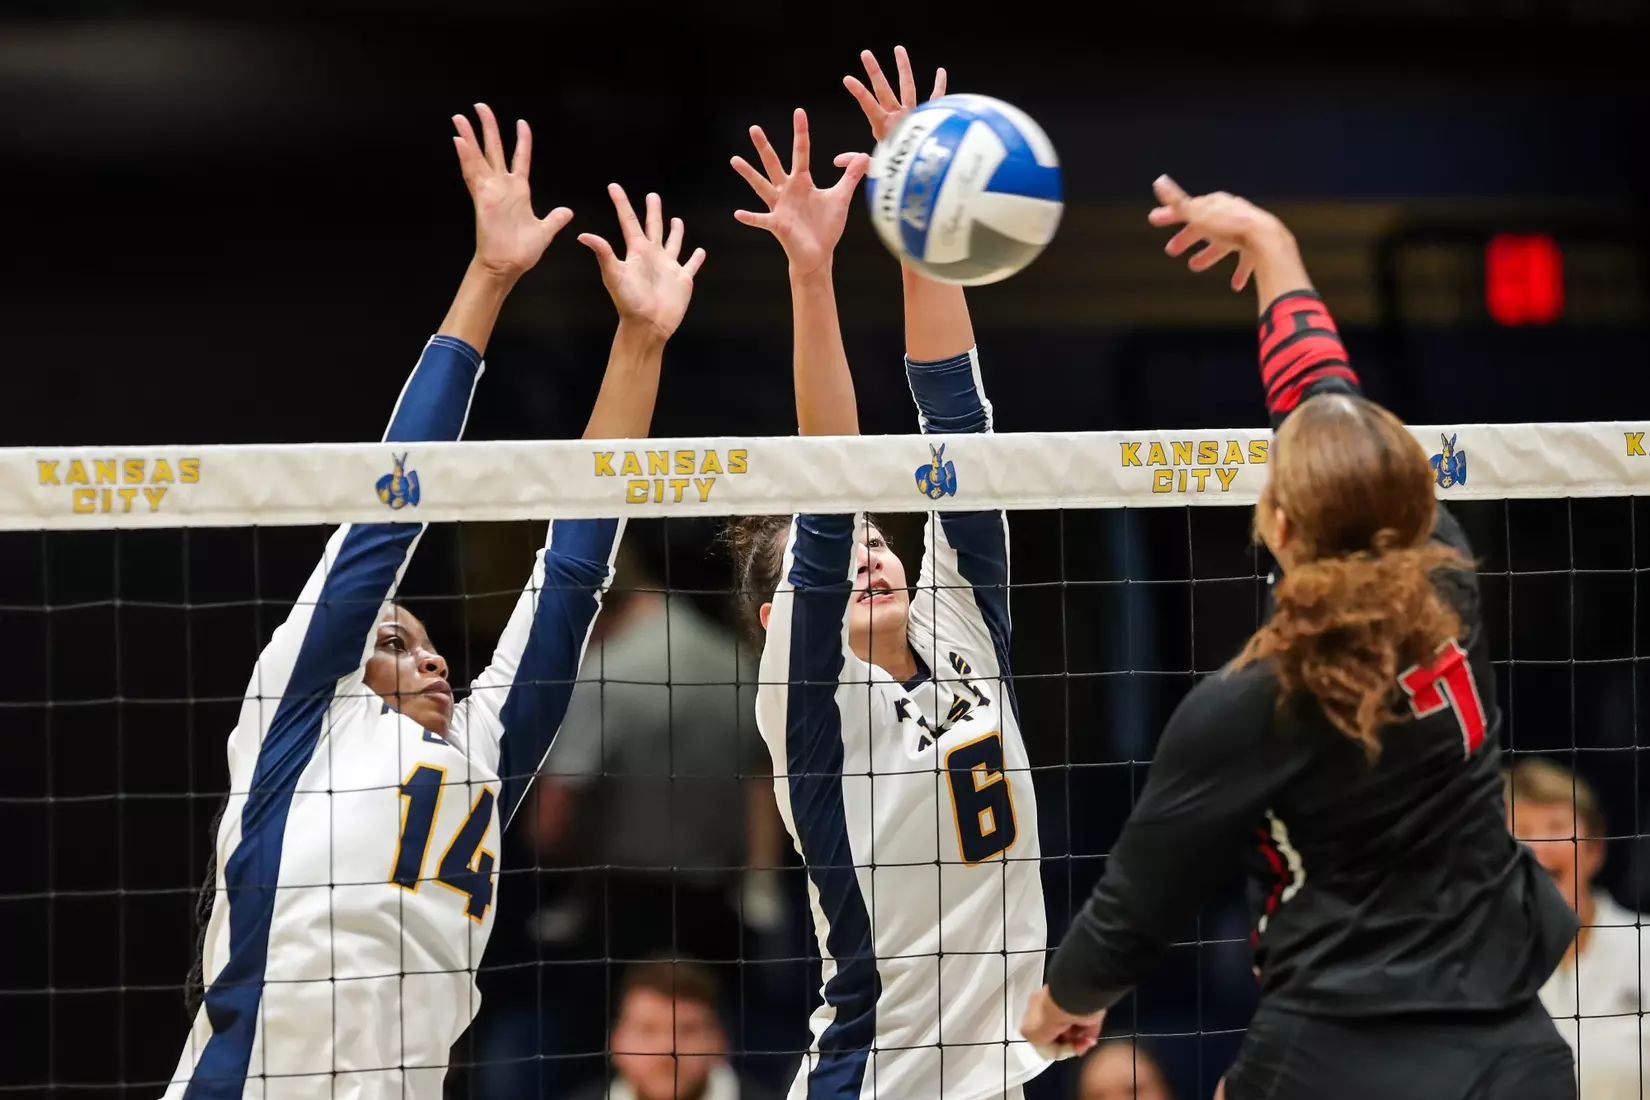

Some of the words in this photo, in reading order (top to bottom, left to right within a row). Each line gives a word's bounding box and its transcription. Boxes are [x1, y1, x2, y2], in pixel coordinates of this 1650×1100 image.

[1119, 440, 1269, 467] KANSAS
[1624, 431, 1650, 457] K
[37, 458, 200, 486] KANSAS
[594, 449, 748, 477] KANSAS
[626, 478, 716, 504] CITY
[1152, 468, 1239, 493] CITY
[72, 487, 168, 514] CITY
[1397, 637, 1488, 761] 7
[944, 730, 1019, 868] 6
[387, 761, 496, 925] 14
